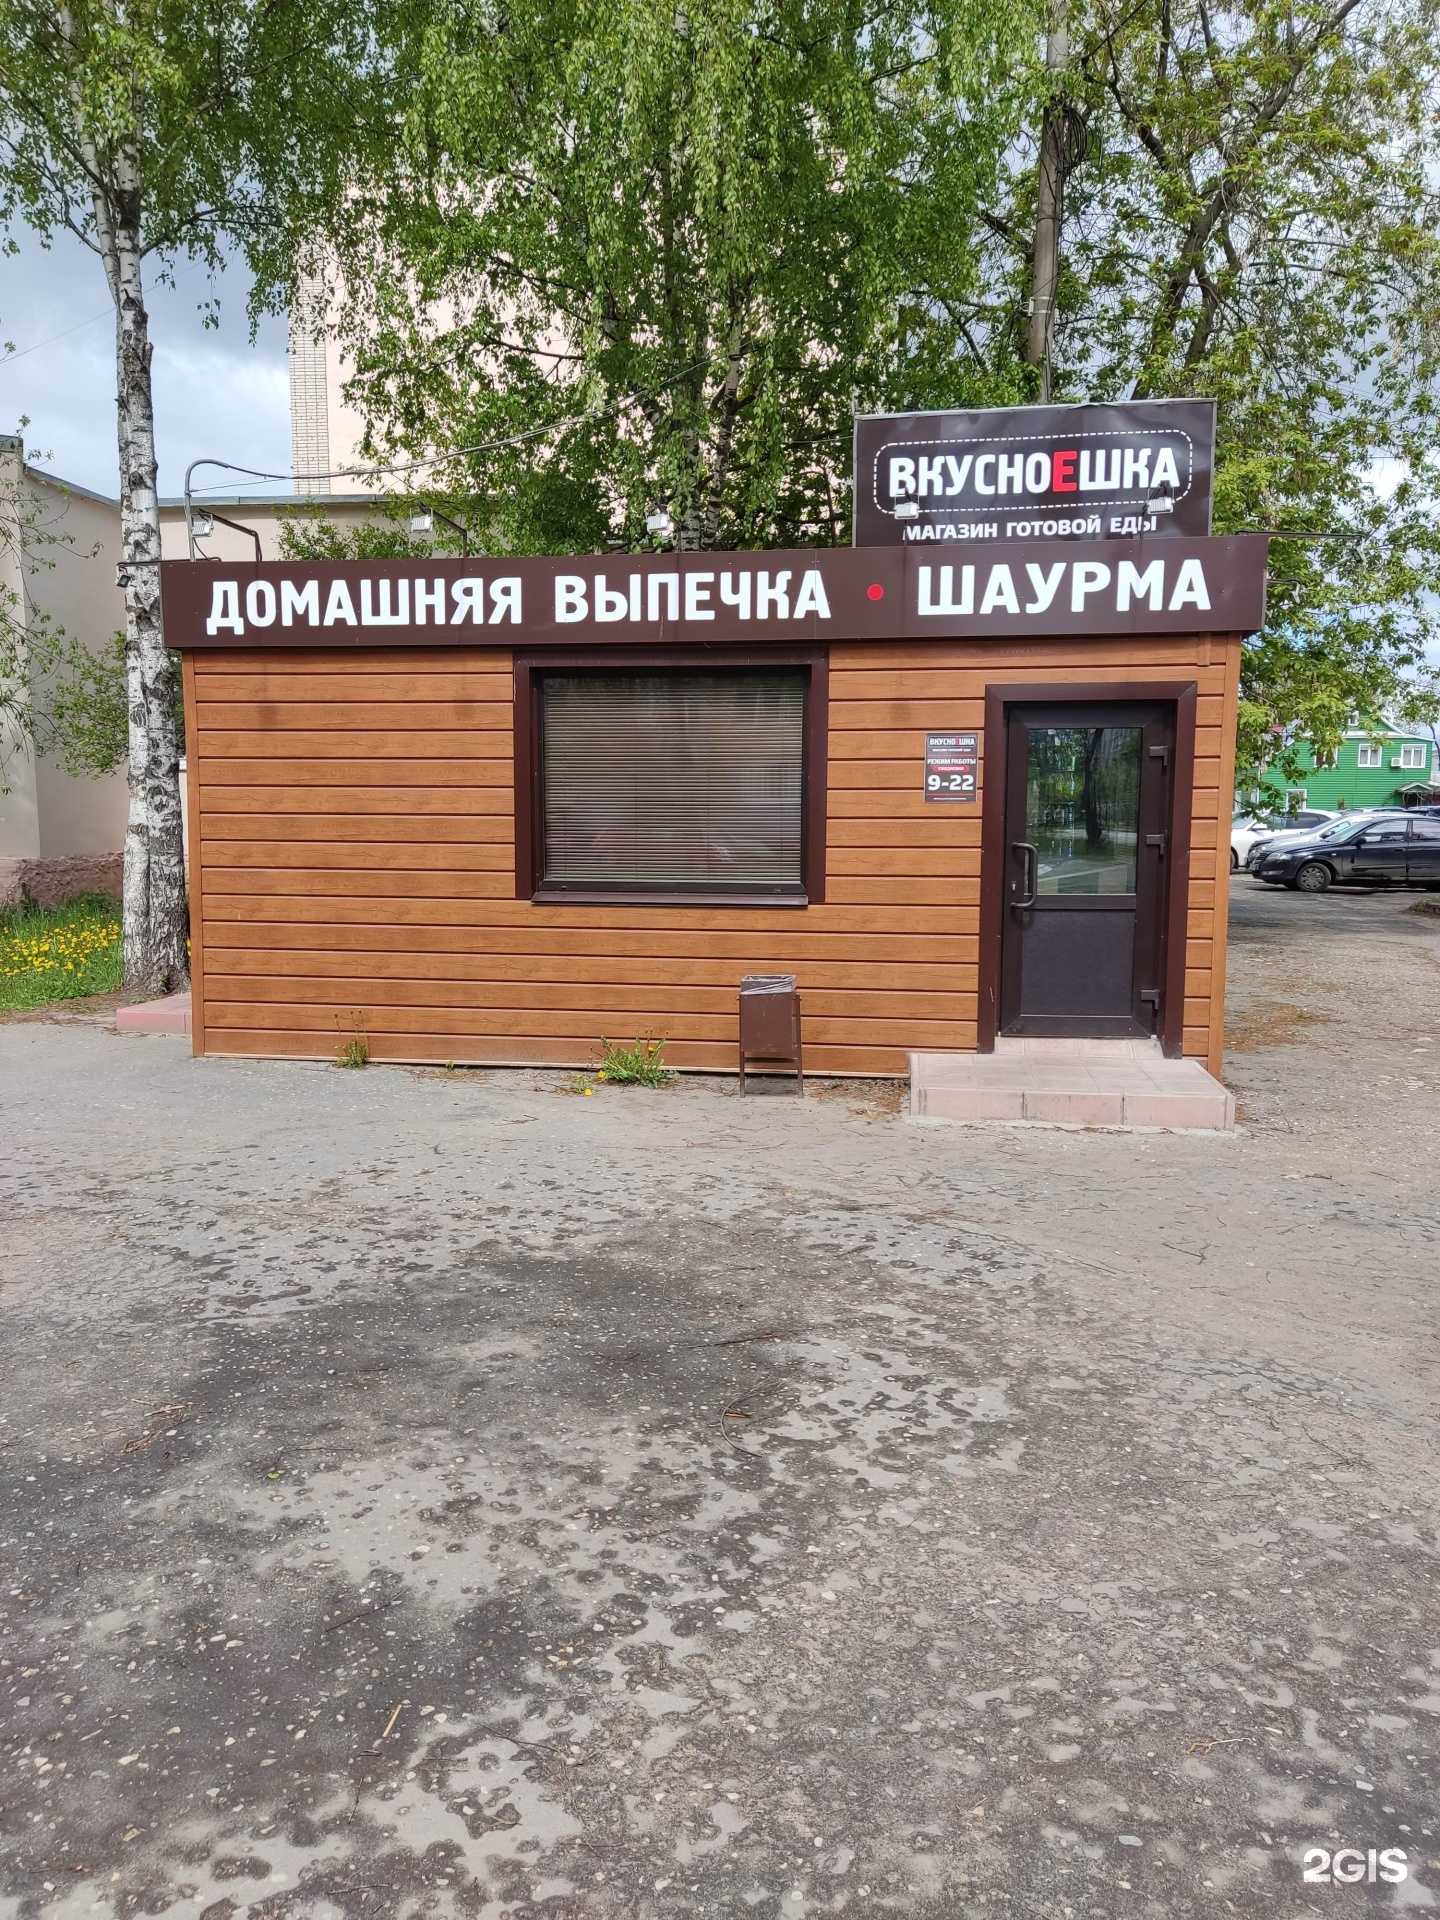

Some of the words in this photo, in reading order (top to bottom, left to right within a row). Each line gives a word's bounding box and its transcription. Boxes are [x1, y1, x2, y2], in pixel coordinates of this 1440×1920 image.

[888, 446, 1181, 498] ВКУСНОЕШКА
[903, 522, 998, 541] МАГАЗИН
[1006, 515, 1102, 537] ГОТОВОЙ
[1110, 515, 1158, 535] ЕДЫ
[206, 577, 522, 636] ДОМАШНЯЯ
[554, 569, 832, 623] ВЫПЕЧКА
[917, 558, 1212, 616] ШАУРМА
[927, 774, 974, 791] 9-22
